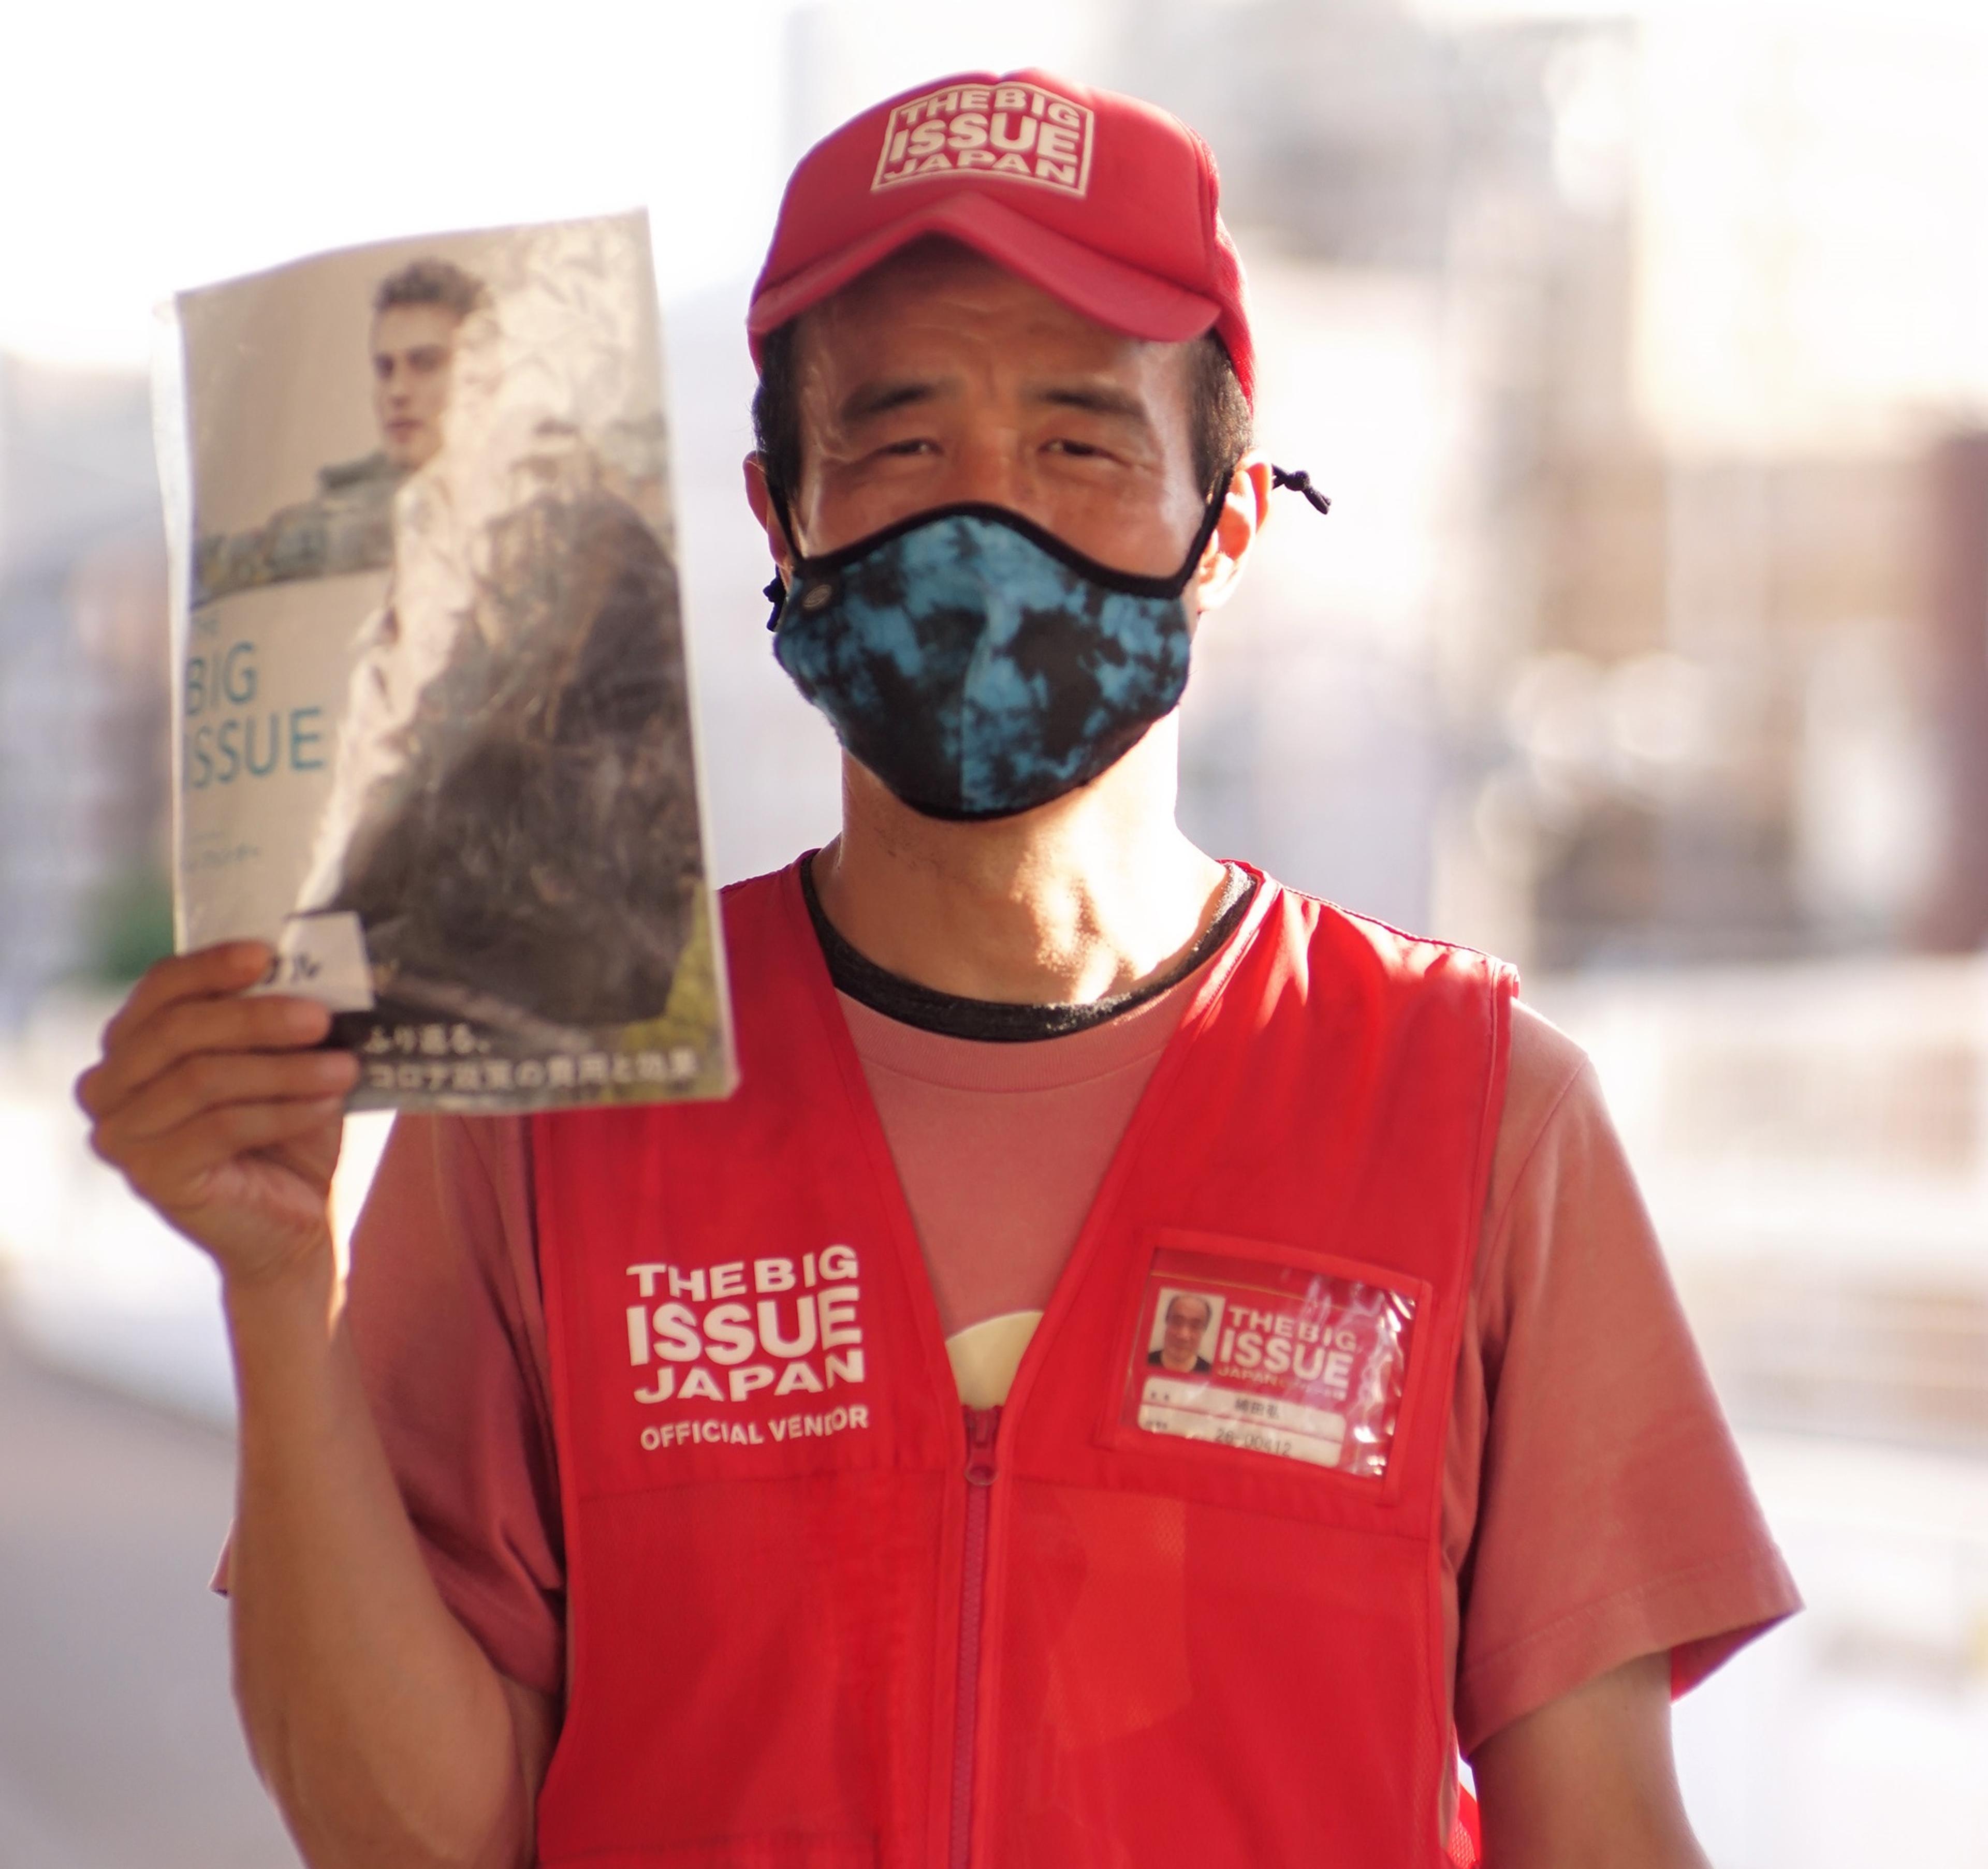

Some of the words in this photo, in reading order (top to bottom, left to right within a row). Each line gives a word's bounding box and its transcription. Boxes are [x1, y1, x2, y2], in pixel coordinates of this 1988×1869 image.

[901, 90, 990, 125] THE
[995, 88, 1080, 128] BIG
[889, 112, 1080, 164] ISSUE
[883, 150, 1077, 184] JAPAN
[186, 641, 257, 717] BIG
[626, 1261, 747, 1302] THE
[754, 1244, 859, 1293] BIG
[626, 1285, 863, 1366] ISSUE
[1229, 1305, 1294, 1338] THE
[1298, 1321, 1356, 1353] BIG
[633, 1348, 865, 1404] JAPAN
[1217, 1366, 1279, 1387] JAPAN
[1220, 1328, 1354, 1388] ISSUE
[640, 1418, 764, 1451] OFFICIAL
